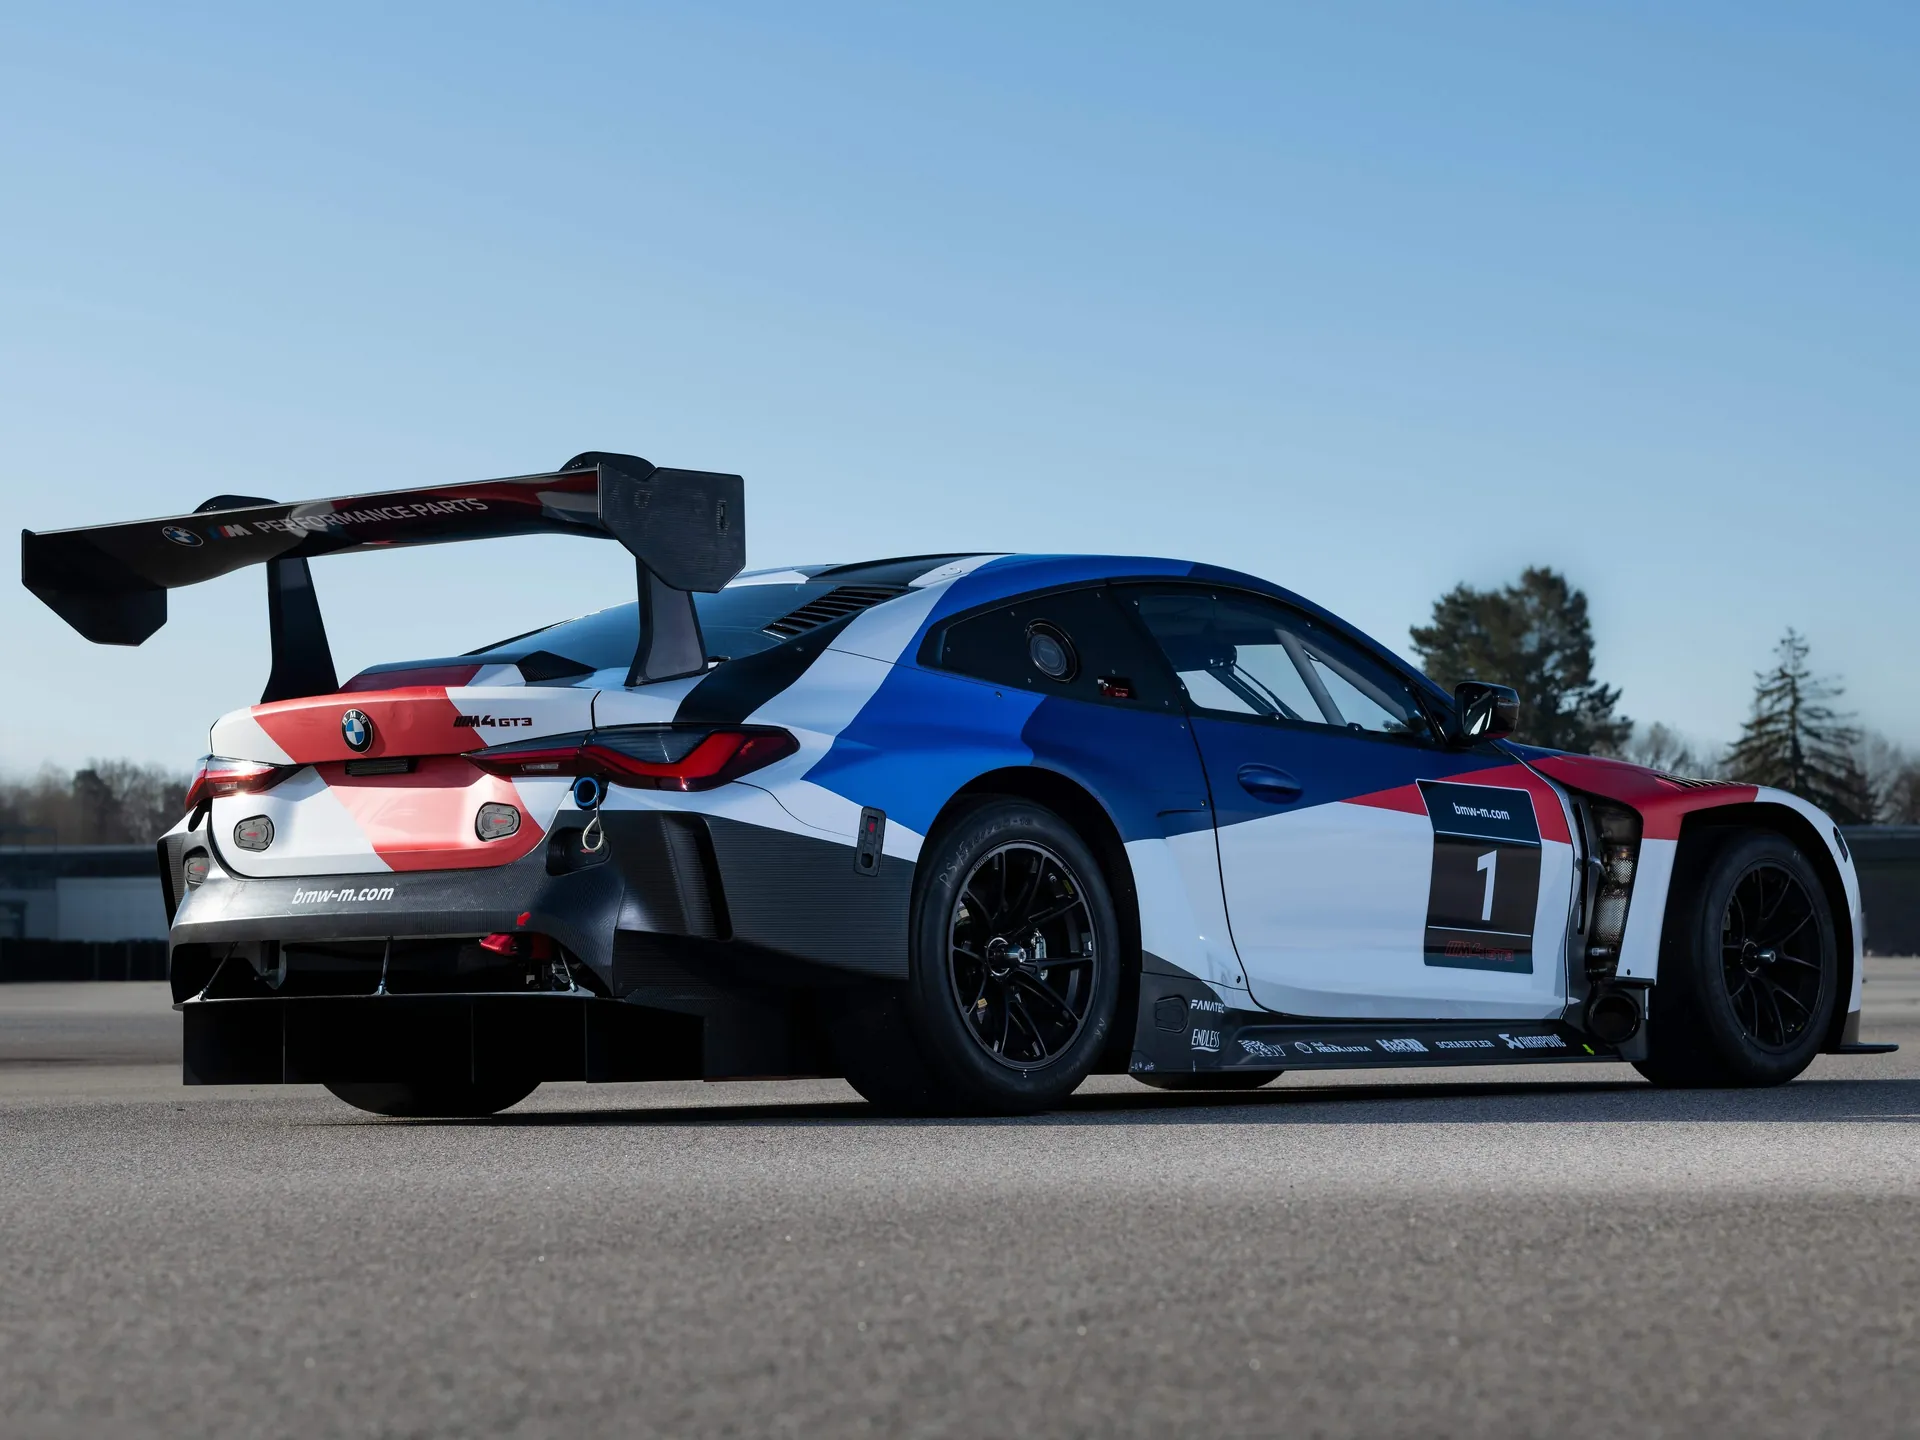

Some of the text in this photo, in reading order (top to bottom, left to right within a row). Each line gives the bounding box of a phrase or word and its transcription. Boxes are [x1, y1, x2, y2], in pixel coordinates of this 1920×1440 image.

[252, 504, 417, 534] PERFORMANCE
[411, 497, 489, 517] PARTS
[498, 717, 532, 727] GT3
[1452, 801, 1511, 821] bmw-m.com
[1476, 849, 1498, 921] 1
[291, 887, 395, 905] bmw-m.com
[1190, 999, 1225, 1013] FANATEC
[1191, 1028, 1220, 1049] ENDLESS
[1435, 1039, 1496, 1049] SCHAEFFLER
[1342, 1045, 1373, 1053] ULTRA
